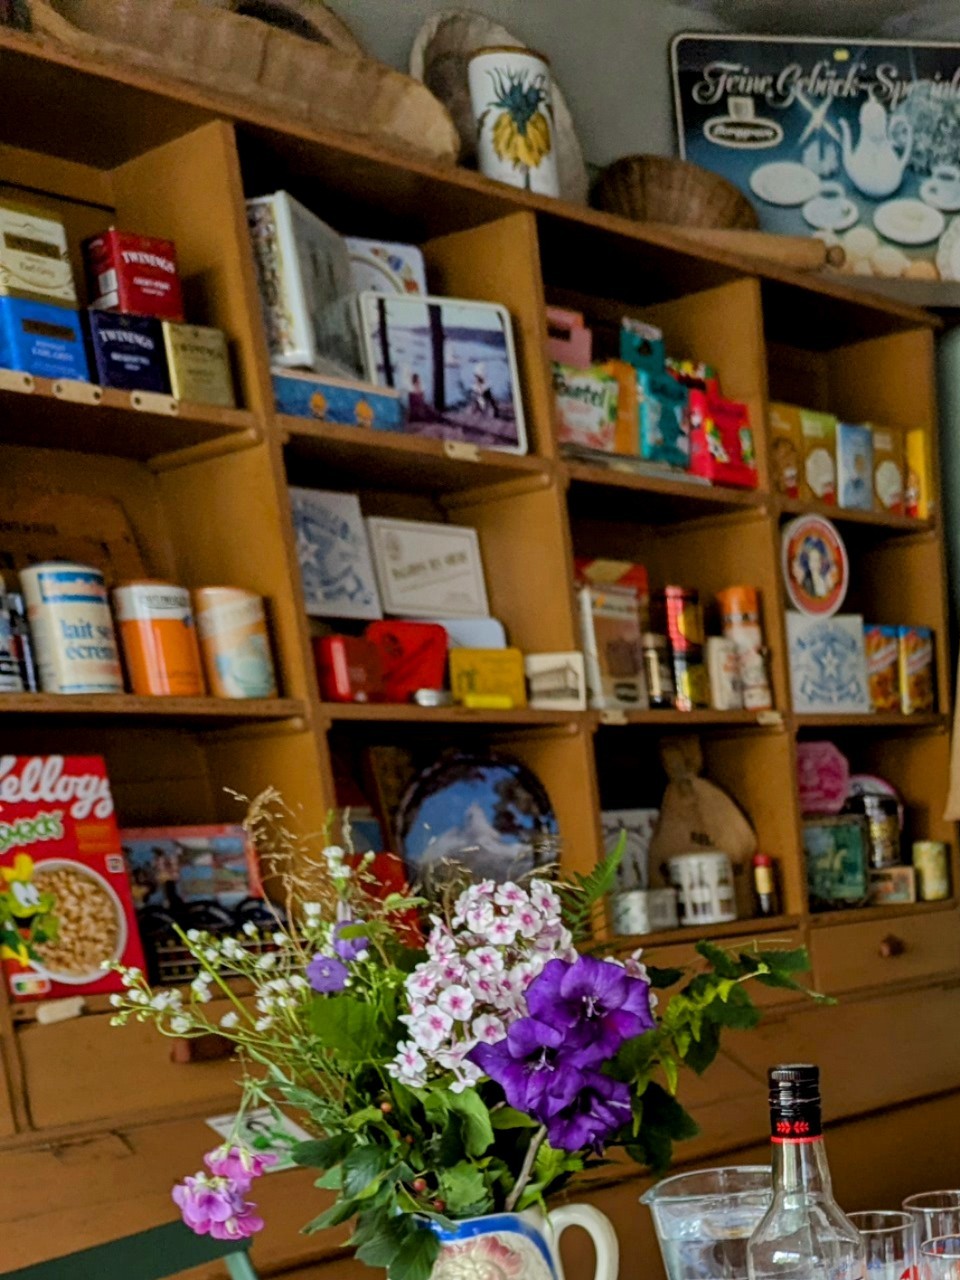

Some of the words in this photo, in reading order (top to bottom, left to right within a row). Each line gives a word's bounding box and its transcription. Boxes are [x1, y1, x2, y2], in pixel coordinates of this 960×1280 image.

[692, 62, 773, 104] Feine
[121, 251, 175, 273] TWININGS
[99, 330, 154, 350] TWININGS
